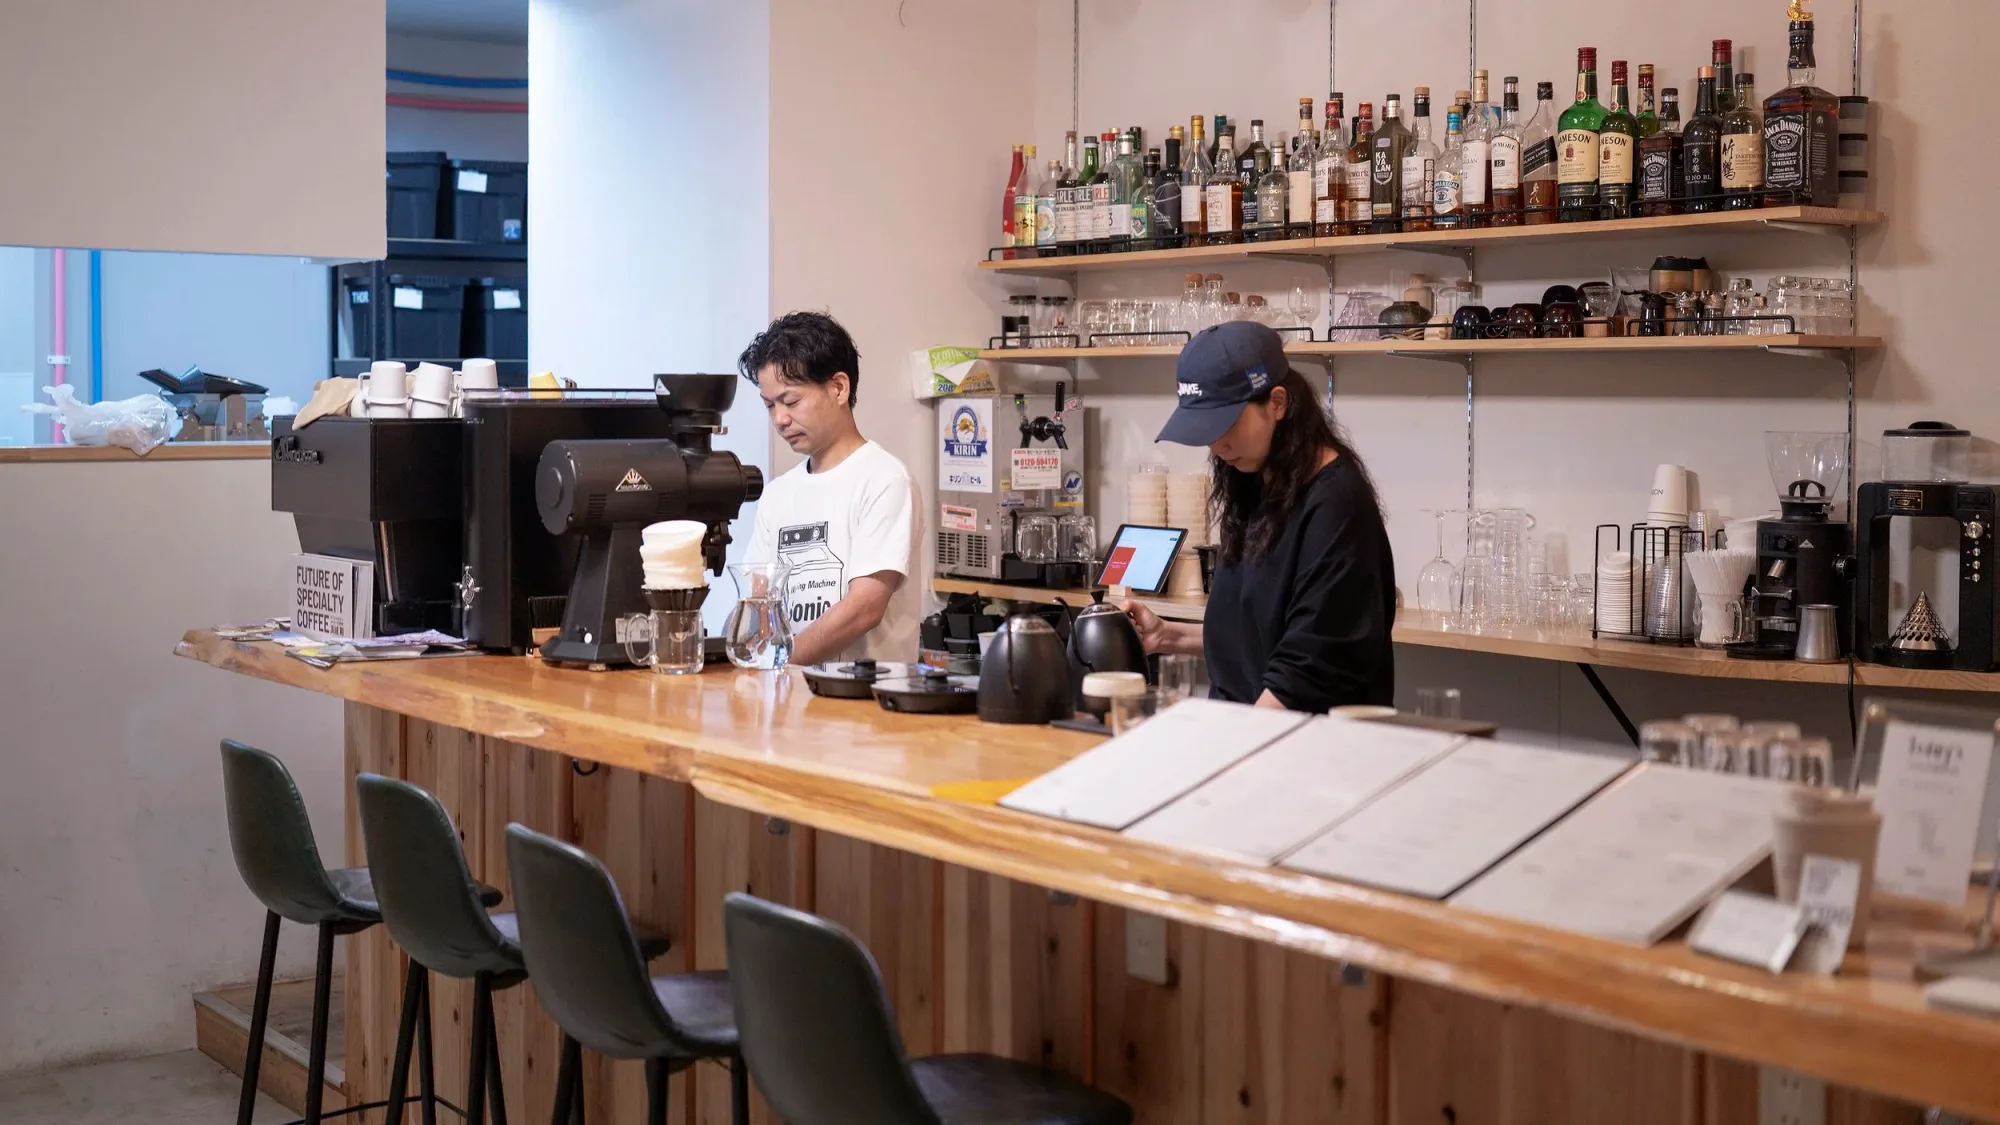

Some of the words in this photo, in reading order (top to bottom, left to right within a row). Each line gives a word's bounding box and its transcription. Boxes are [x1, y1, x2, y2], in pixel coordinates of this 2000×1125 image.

[1764, 123, 1780, 138] JACK
[1780, 120, 1805, 135] DANIEL'S
[1375, 164, 1391, 172] LAN
[1691, 148, 1700, 173] 季の美
[1722, 139, 1736, 180] 竹鶴
[938, 383, 953, 393] 200
[953, 444, 977, 456] KIRIN
[296, 565, 330, 589] FUTURE
[332, 571, 344, 592] OF
[807, 579, 837, 590] Machine
[296, 587, 344, 614] SPECIALTY
[297, 608, 330, 634] COFFEE
